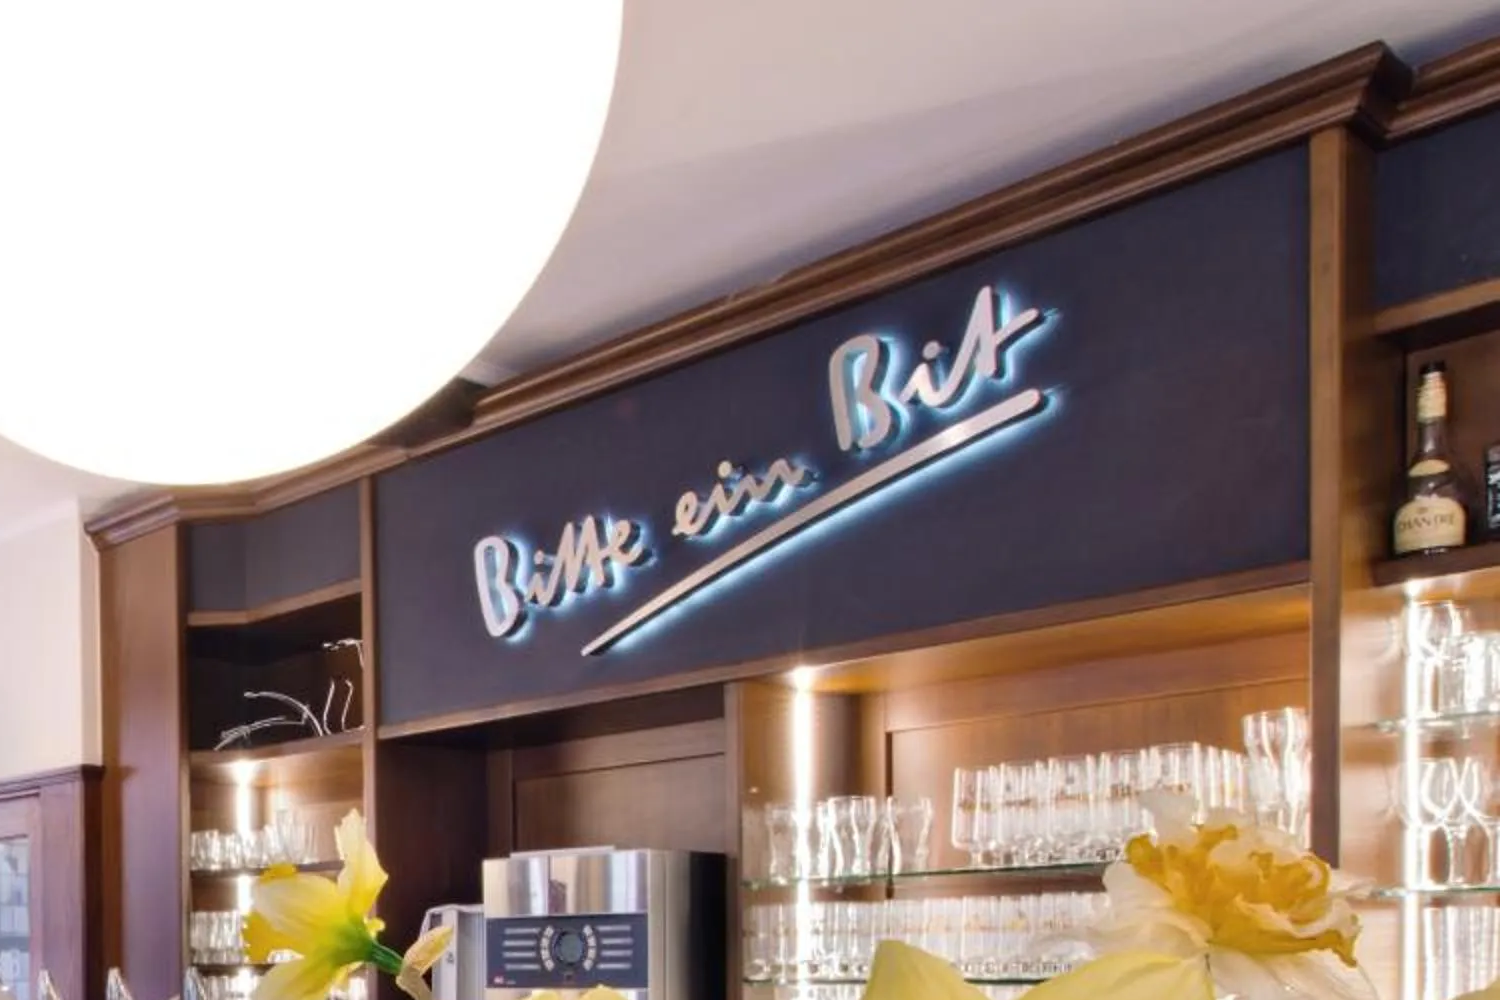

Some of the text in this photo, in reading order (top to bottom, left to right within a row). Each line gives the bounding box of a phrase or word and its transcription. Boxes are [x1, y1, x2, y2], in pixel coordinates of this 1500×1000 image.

[474, 286, 1040, 637] Bitte ein Bit
